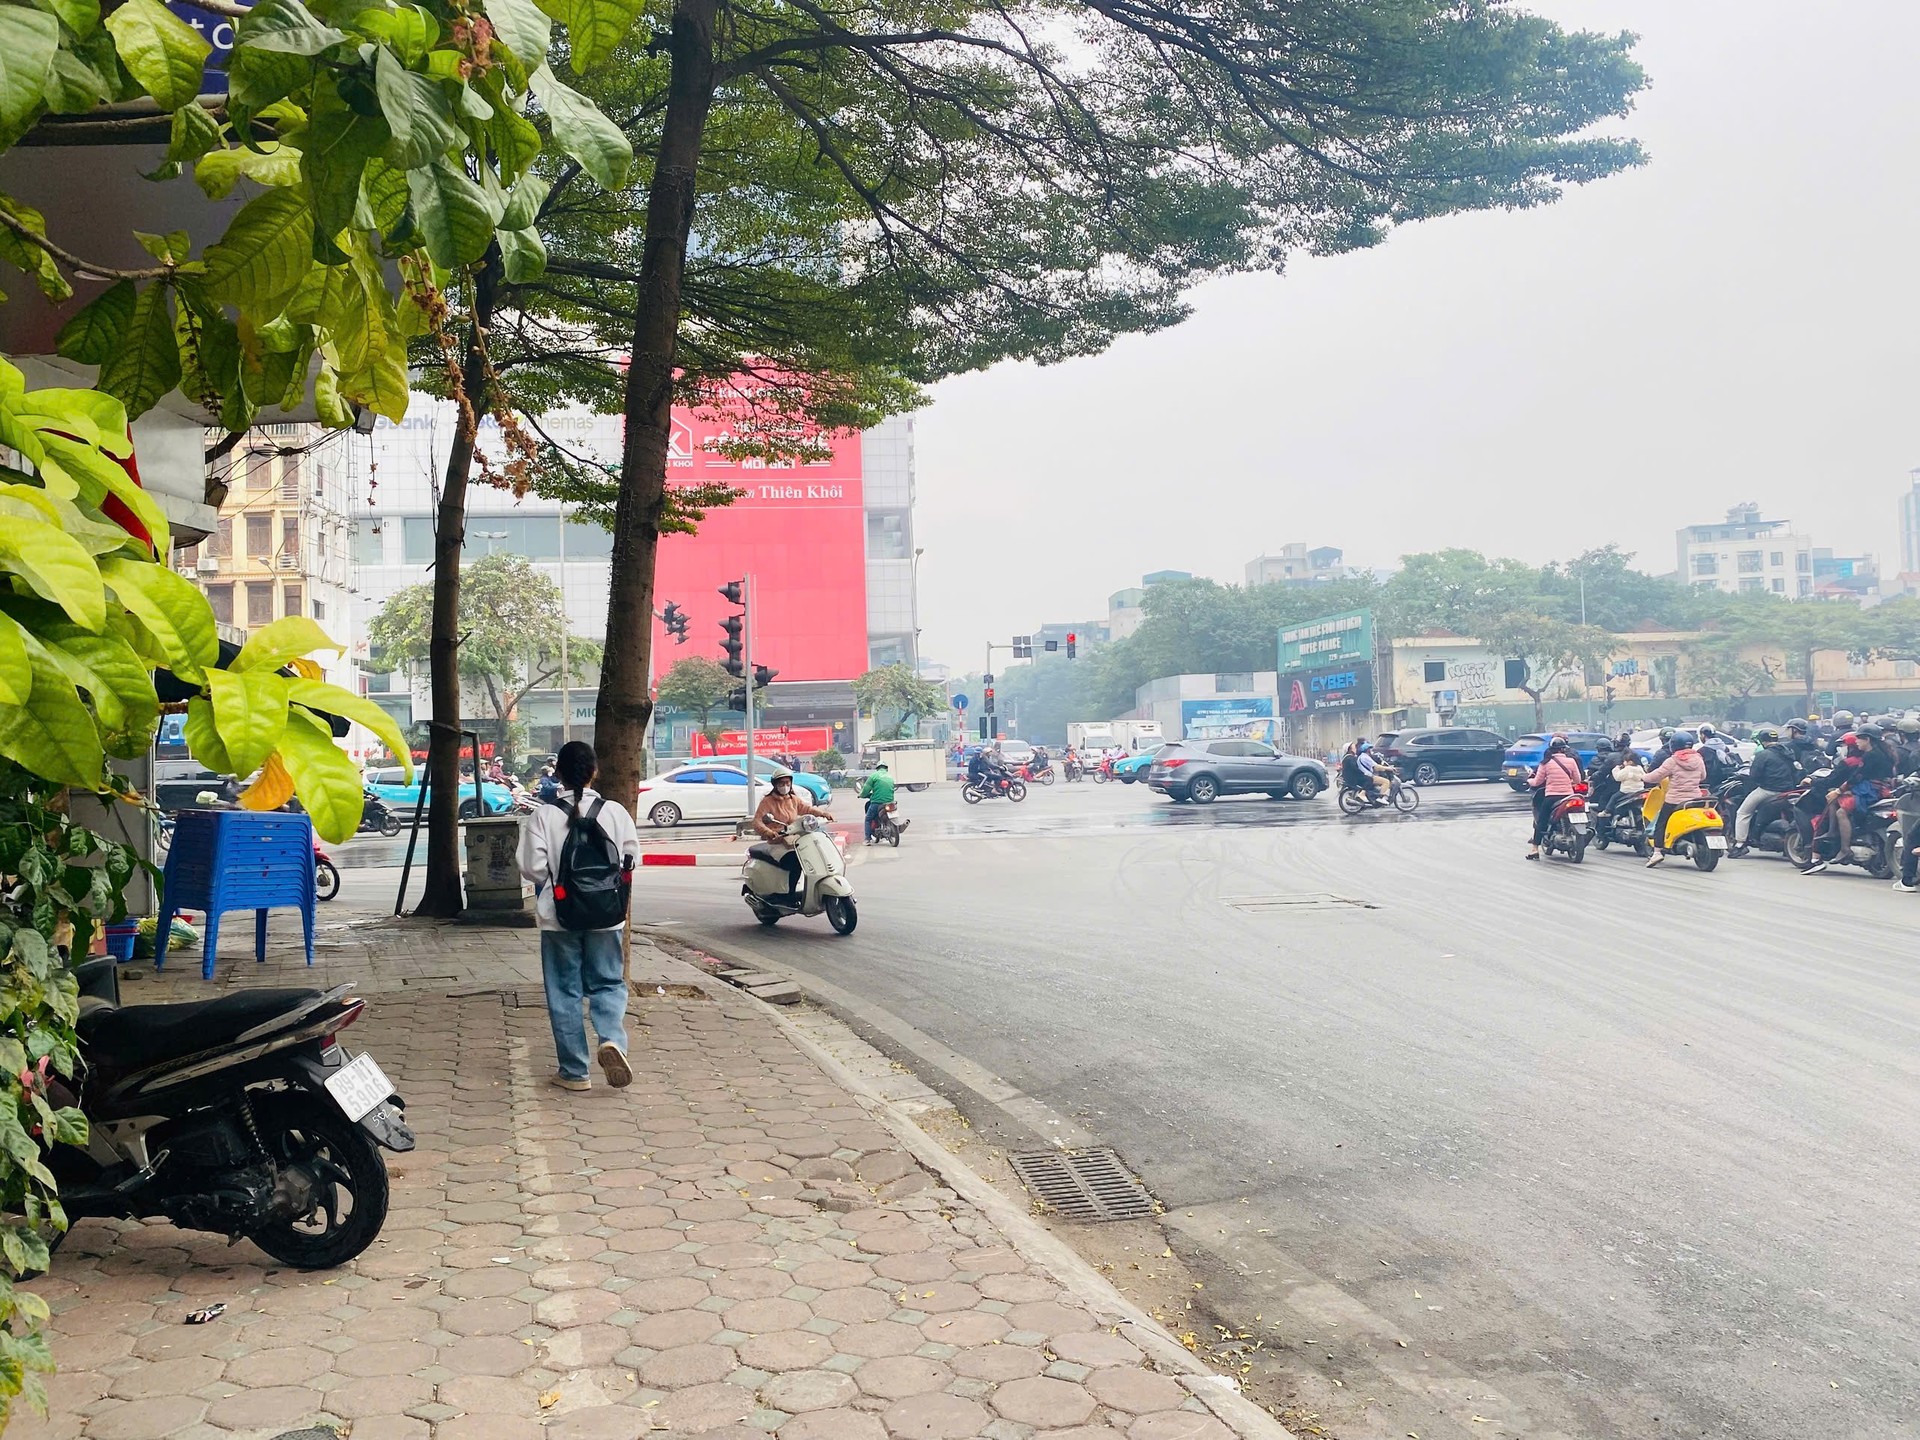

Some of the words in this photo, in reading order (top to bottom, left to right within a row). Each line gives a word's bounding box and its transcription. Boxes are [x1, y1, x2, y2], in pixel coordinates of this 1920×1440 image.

[758, 485, 803, 499] Thiên
[807, 485, 843, 499] Khôi
[1311, 672, 1356, 692] CYBER
[347, 1078, 387, 1114] 5906
